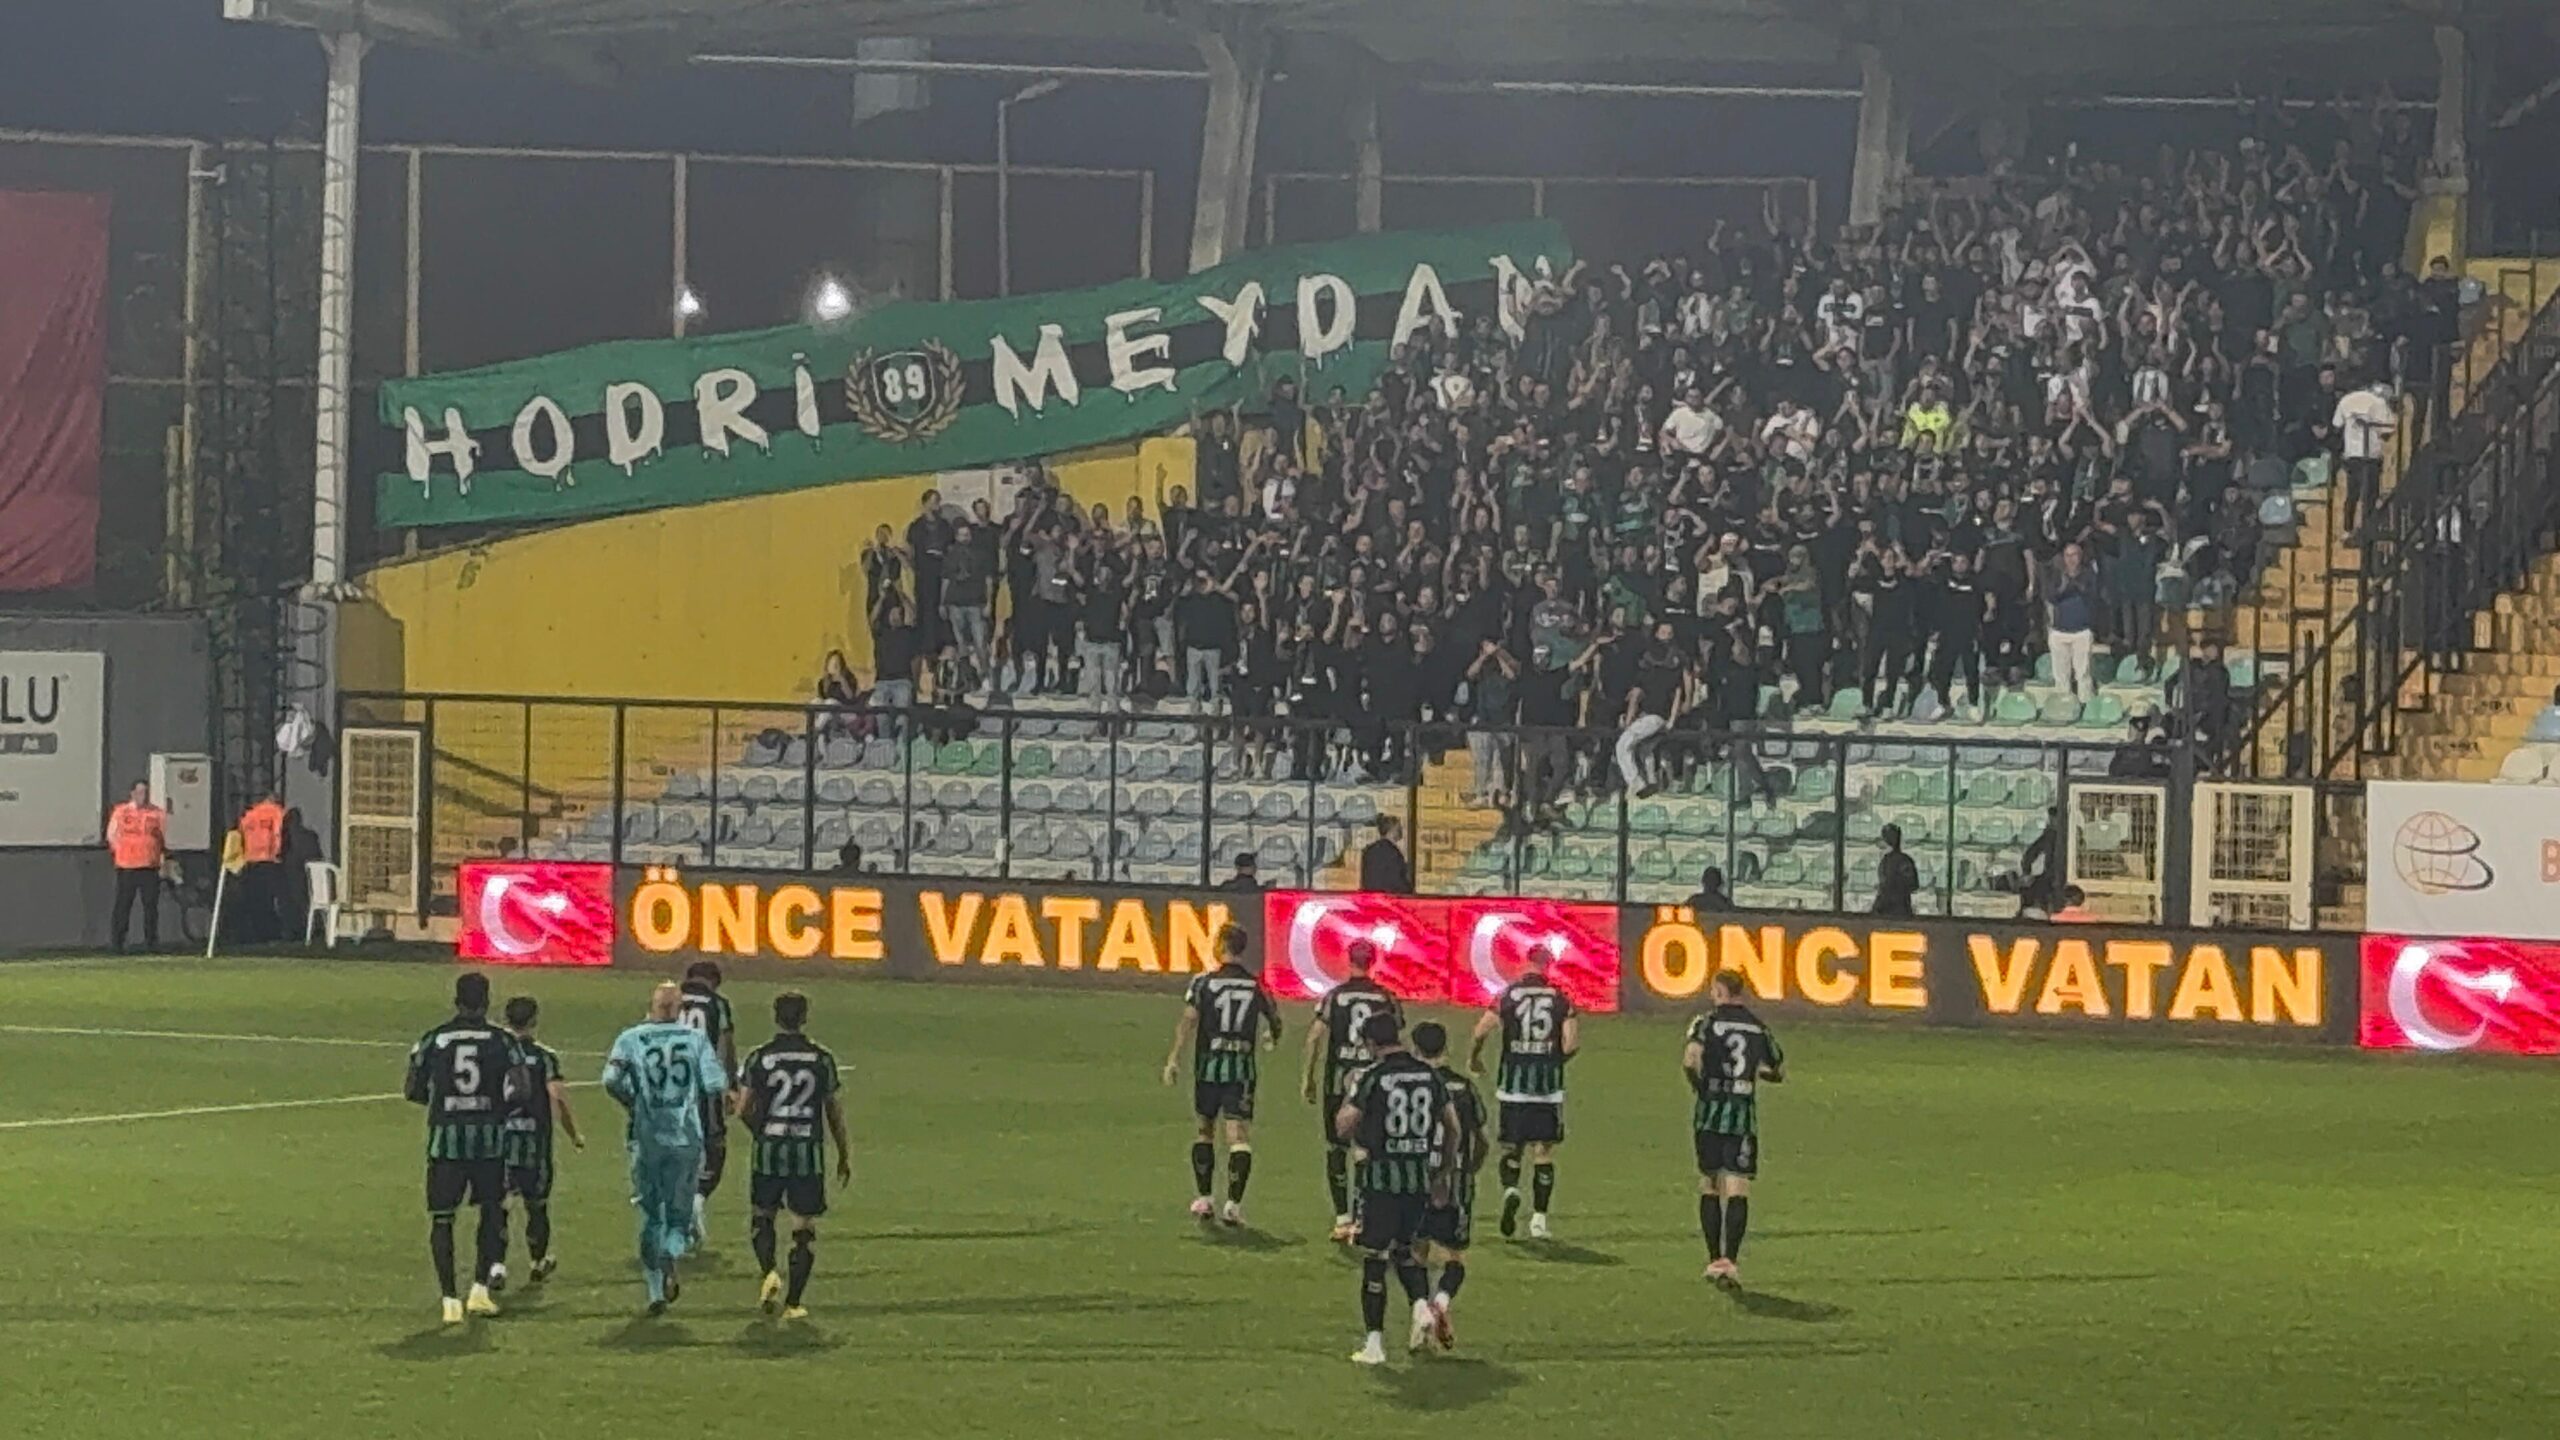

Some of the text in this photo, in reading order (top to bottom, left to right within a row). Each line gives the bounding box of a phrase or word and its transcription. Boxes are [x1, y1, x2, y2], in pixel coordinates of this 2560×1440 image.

[883, 364, 926, 403] 89
[632, 865, 1230, 973] ÖNCE VATAN
[1641, 905, 2322, 1026] ÖNCE VATAN
[1214, 989, 1254, 1033] 17
[1516, 997, 1553, 1041] 15
[454, 1045, 480, 1095] 5
[644, 1043, 691, 1090] 35
[1722, 1034, 1747, 1078] 3
[766, 1068, 816, 1118] 22
[1384, 1086, 1433, 1138] 88
